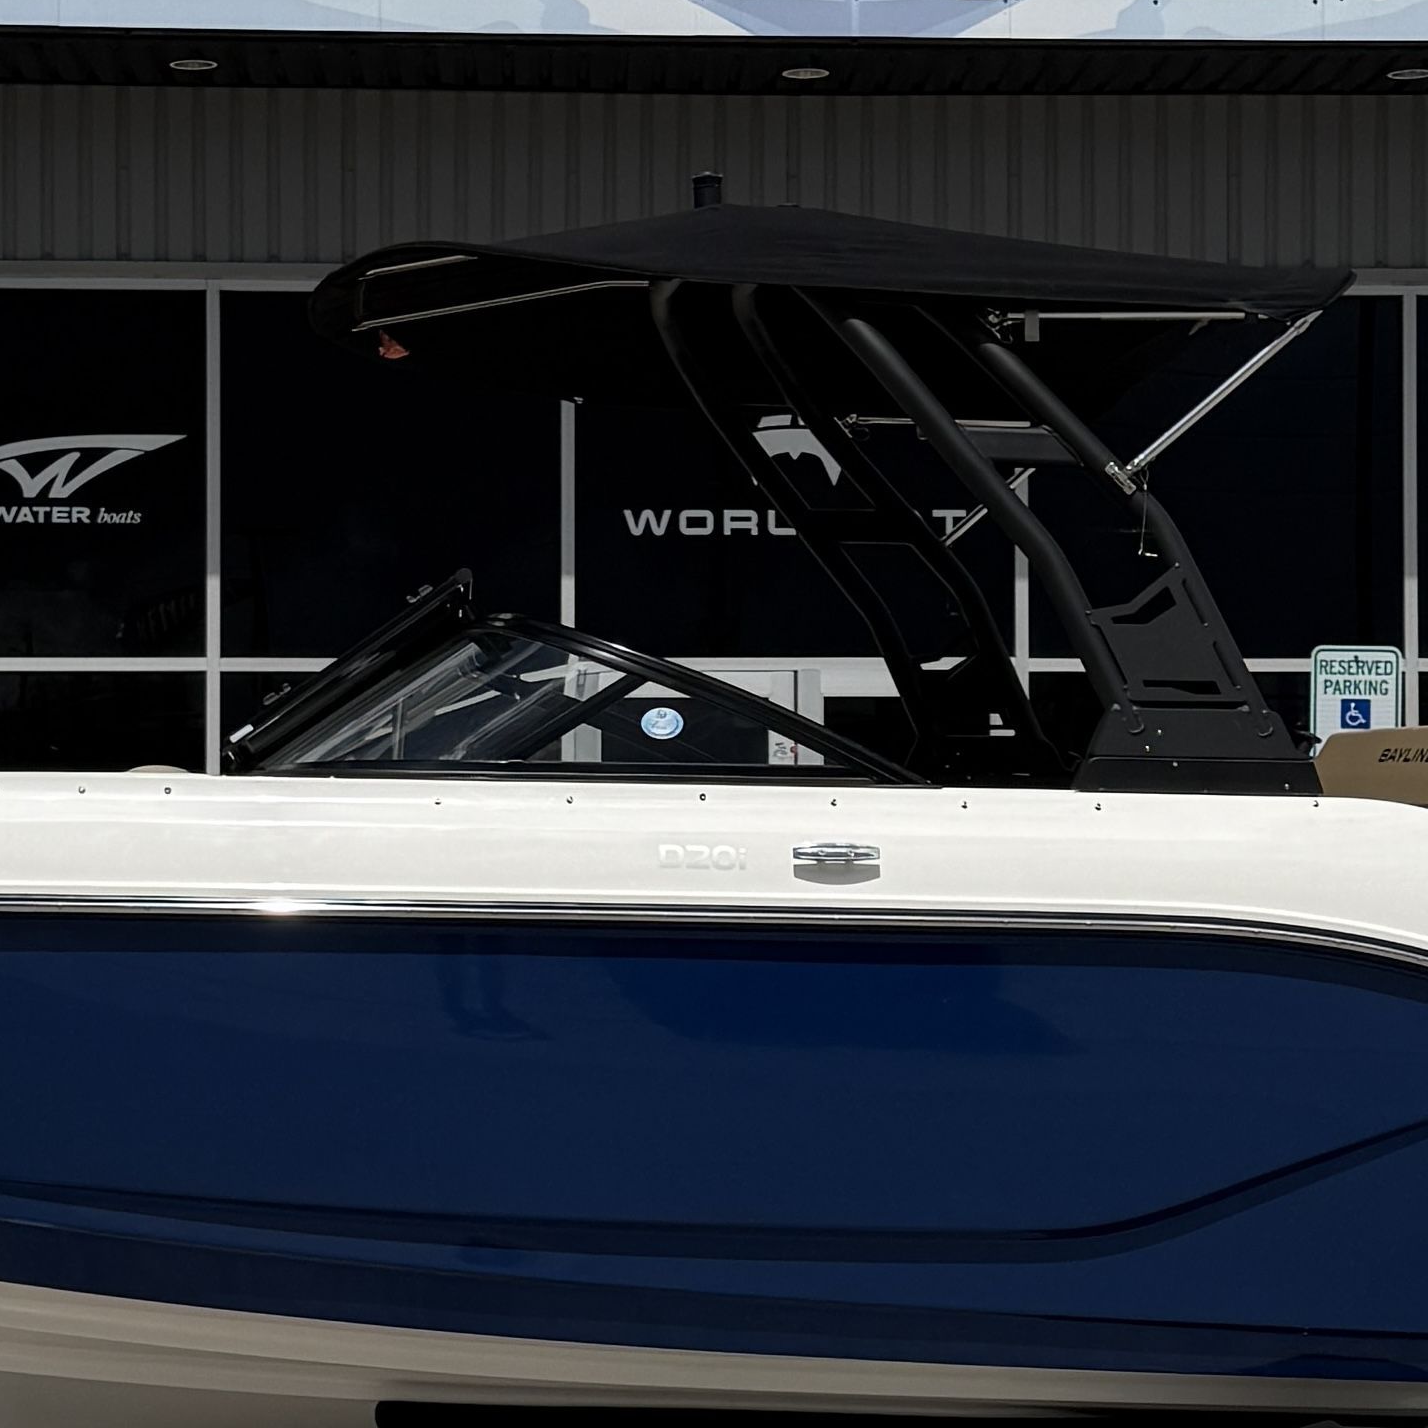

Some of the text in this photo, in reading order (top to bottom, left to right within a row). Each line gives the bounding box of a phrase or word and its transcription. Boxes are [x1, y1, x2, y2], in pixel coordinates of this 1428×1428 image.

[96, 507, 142, 526] boats
[623, 508, 798, 537] WORL
[1319, 658, 1394, 676] RESERVED
[1323, 678, 1390, 696] PARKING
